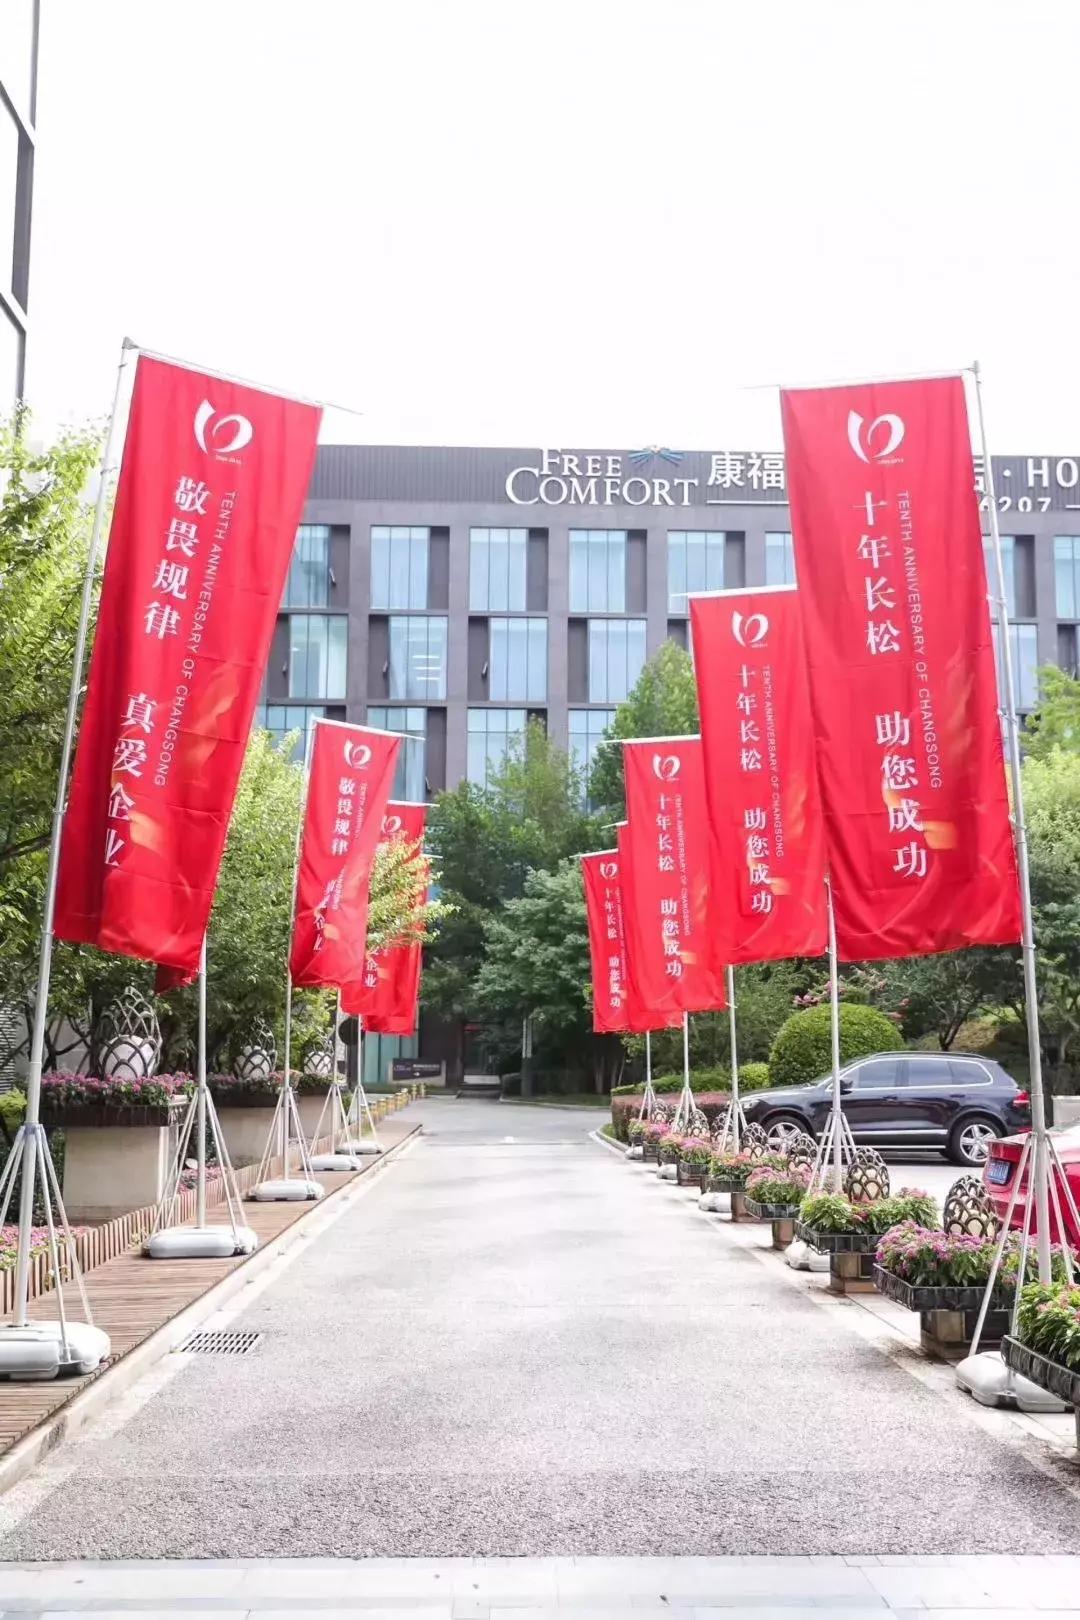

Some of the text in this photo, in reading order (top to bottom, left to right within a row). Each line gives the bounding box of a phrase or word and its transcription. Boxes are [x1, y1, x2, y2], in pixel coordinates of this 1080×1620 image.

[214, 490, 236, 541] TENTH
[505, 466, 699, 506] COMFORT
[540, 449, 622, 477] FREE
[707, 451, 786, 490] 康福
[144, 475, 212, 640] 敬畏规律
[187, 543, 223, 654] ANNIVERSARY
[852, 490, 901, 655] 十年长松
[181, 658, 195, 680] OF
[896, 489, 942, 789] TENTH ANNIVERSARY OF CHANGSONG
[154, 684, 189, 786] CHANGSONG
[735, 664, 762, 772] 十年长松
[875, 711, 928, 878] 助您成功
[655, 792, 682, 978] 十年长松 助您成功
[744, 807, 773, 914] 助您成功
